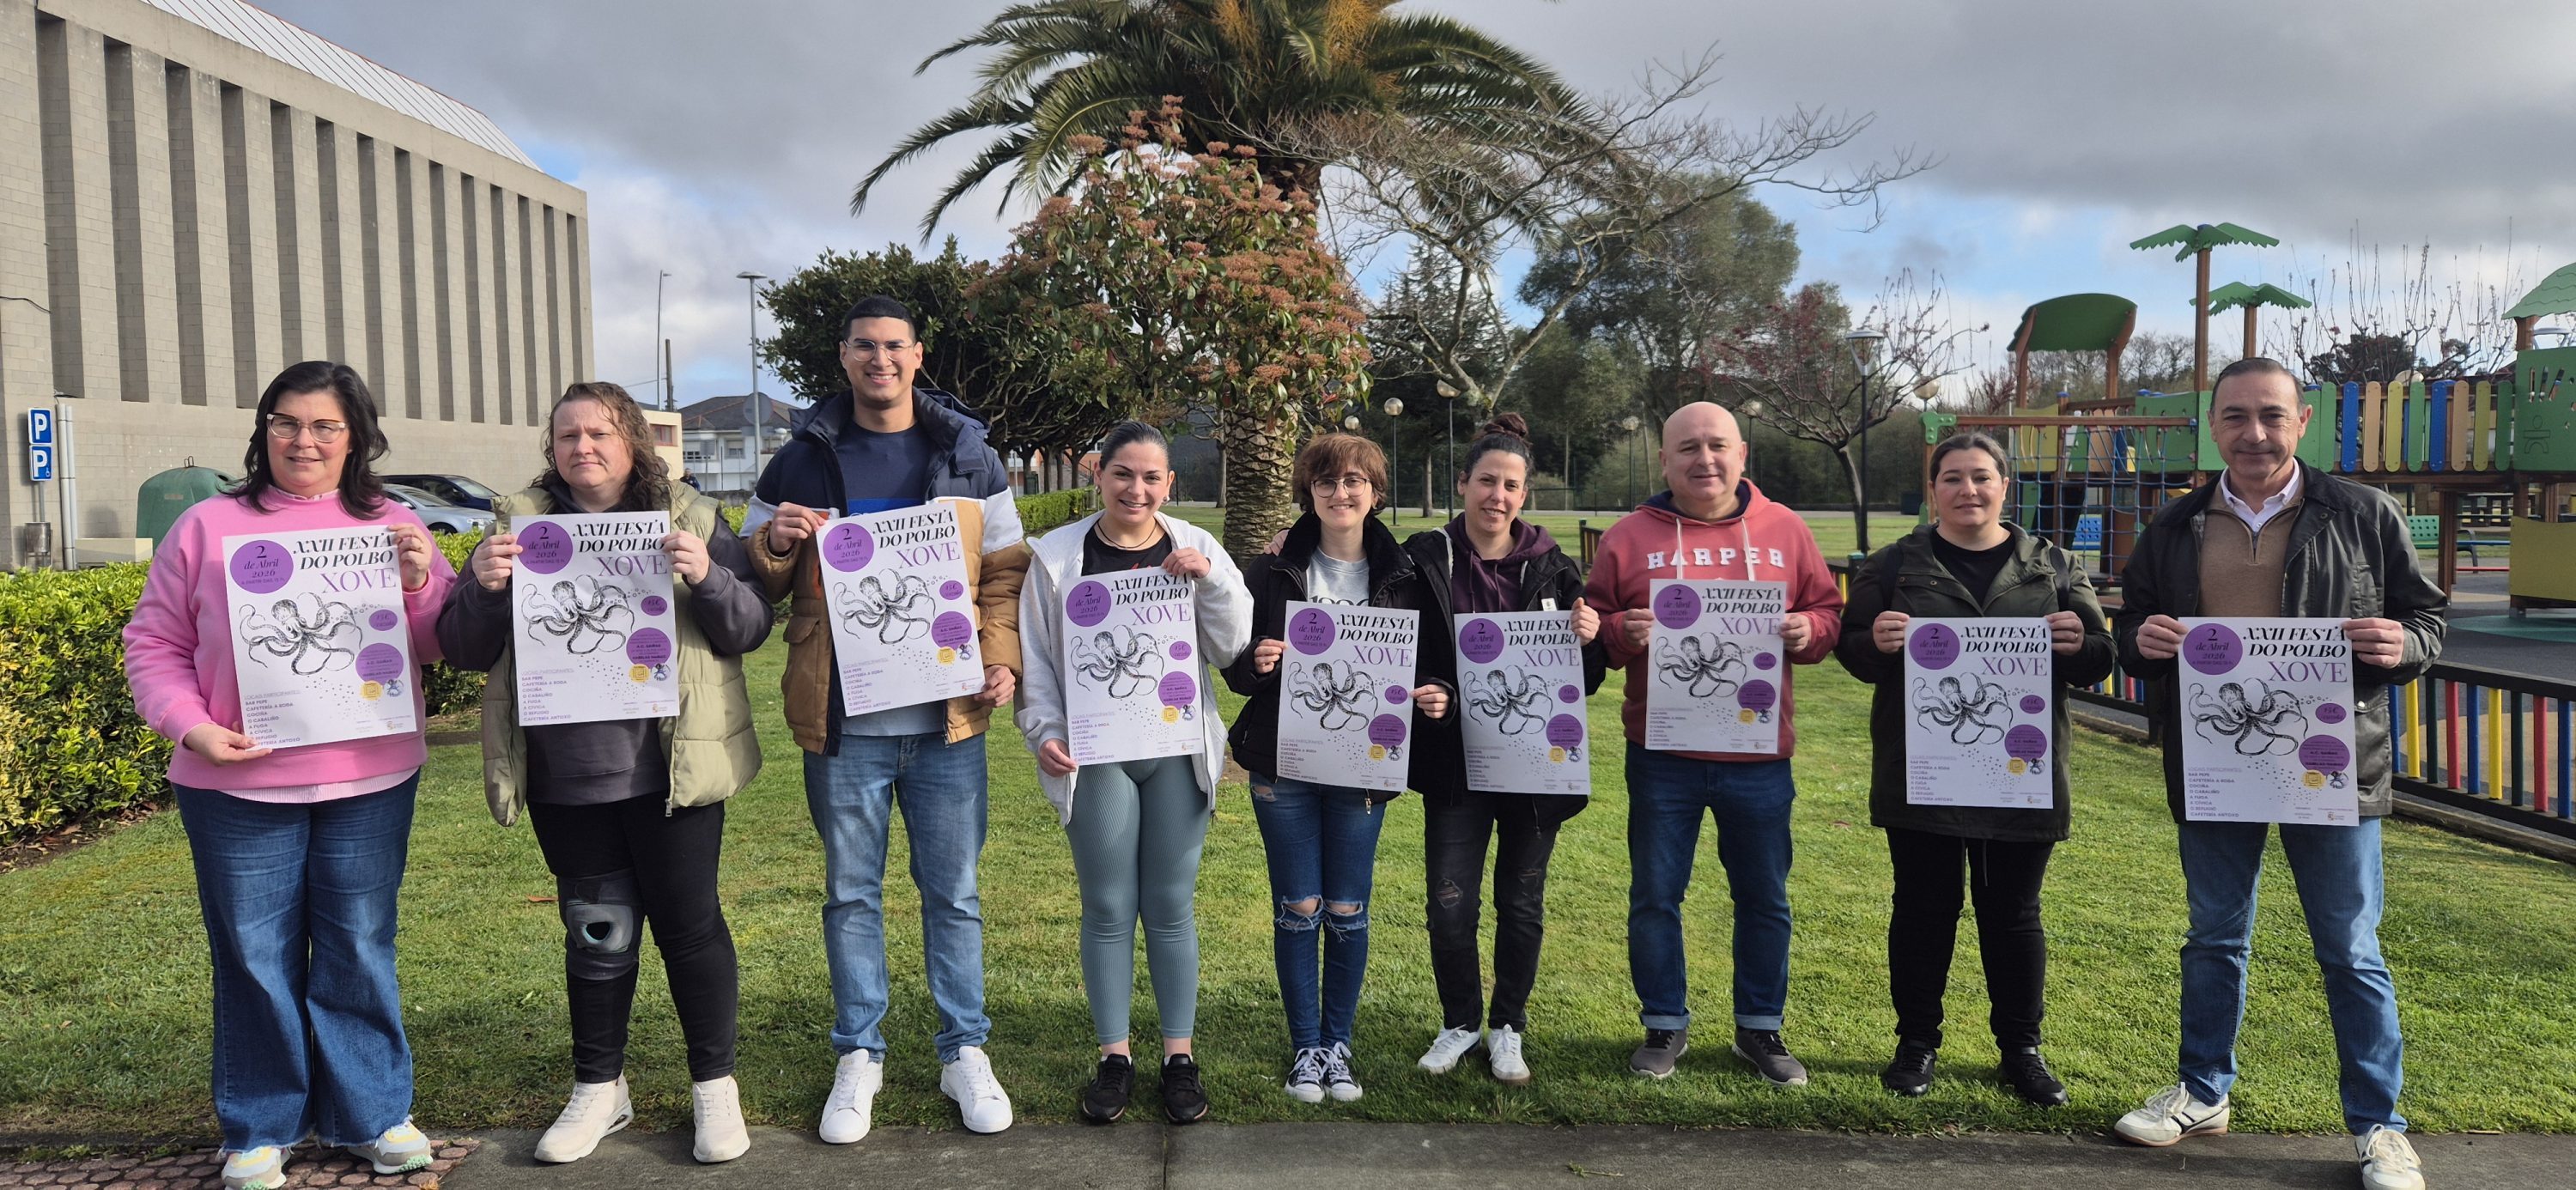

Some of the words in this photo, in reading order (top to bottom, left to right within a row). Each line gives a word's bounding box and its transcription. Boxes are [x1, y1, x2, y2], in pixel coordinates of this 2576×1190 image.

[34, 413, 47, 440] P
[33, 450, 48, 477] P
[572, 523, 610, 537] XXII
[613, 519, 665, 535] FESTA
[872, 518, 905, 534] XXII
[908, 508, 953, 528] FESTA
[539, 526, 549, 539] 2
[842, 527, 852, 540] 2
[879, 533, 902, 548] DO
[905, 525, 955, 543] POLBO
[293, 538, 333, 554] XXII
[338, 532, 392, 550] FESTA
[528, 541, 538, 549] de
[541, 539, 560, 549] Abril
[579, 539, 605, 552] DO
[607, 537, 665, 552] POLBO
[834, 542, 843, 550] de
[843, 537, 862, 549] Abril
[255, 544, 266, 558] 2
[841, 549, 860, 557] 2026
[896, 541, 960, 568] XOVE
[244, 560, 255, 569] de
[258, 557, 279, 568] Abril
[300, 555, 328, 569] DO
[332, 549, 393, 567] POLBO
[596, 554, 668, 577] XOVE
[1647, 547, 1785, 570] HARPER
[252, 569, 275, 578] 2026
[320, 568, 397, 593] XOVE
[1110, 577, 1142, 592] XXII
[1145, 573, 1188, 587] FESTA
[1084, 586, 1092, 597] 2
[1115, 592, 1138, 605] DO
[1140, 586, 1189, 602] POLBO
[1674, 588, 1682, 599] 2
[1701, 587, 1735, 599] XXII
[1737, 587, 1781, 600] FESTA
[1075, 598, 1084, 607] de
[1084, 596, 1101, 605] Abril
[1705, 602, 1728, 613] DO
[1730, 602, 1781, 614] POLBO
[1130, 602, 1191, 626] XOVE
[1309, 612, 1317, 623] 2
[1335, 613, 1369, 627] XXII
[1370, 616, 1413, 630] FESTA
[1478, 622, 1485, 633] 2
[1504, 620, 1534, 632] XXII
[1537, 618, 1572, 631] FEST
[1720, 616, 1779, 635] XOVE
[1309, 624, 1325, 634] Abril
[1339, 628, 1362, 641] DO
[1364, 630, 1413, 644] POLBO
[1930, 627, 1939, 638] 2
[1960, 626, 1996, 638] XXII
[1998, 624, 2046, 638] FESTA
[2207, 628, 2217, 641] 2
[2242, 627, 2285, 641] XXII
[2287, 626, 2346, 641] FESTA
[1509, 634, 1530, 646] DO
[1533, 633, 1577, 646] POLBO
[1930, 638, 1948, 647] Abril
[2208, 641, 2229, 650] Abril
[1965, 641, 1990, 653] DO
[1992, 641, 2047, 653] POLBO
[2249, 643, 2277, 656] DO
[2281, 643, 2346, 658] POLBO
[1352, 644, 1412, 667] XOVE
[1522, 647, 1580, 667] XOVE
[1981, 656, 2047, 676] XOVE
[2268, 660, 2348, 683] XOVE
